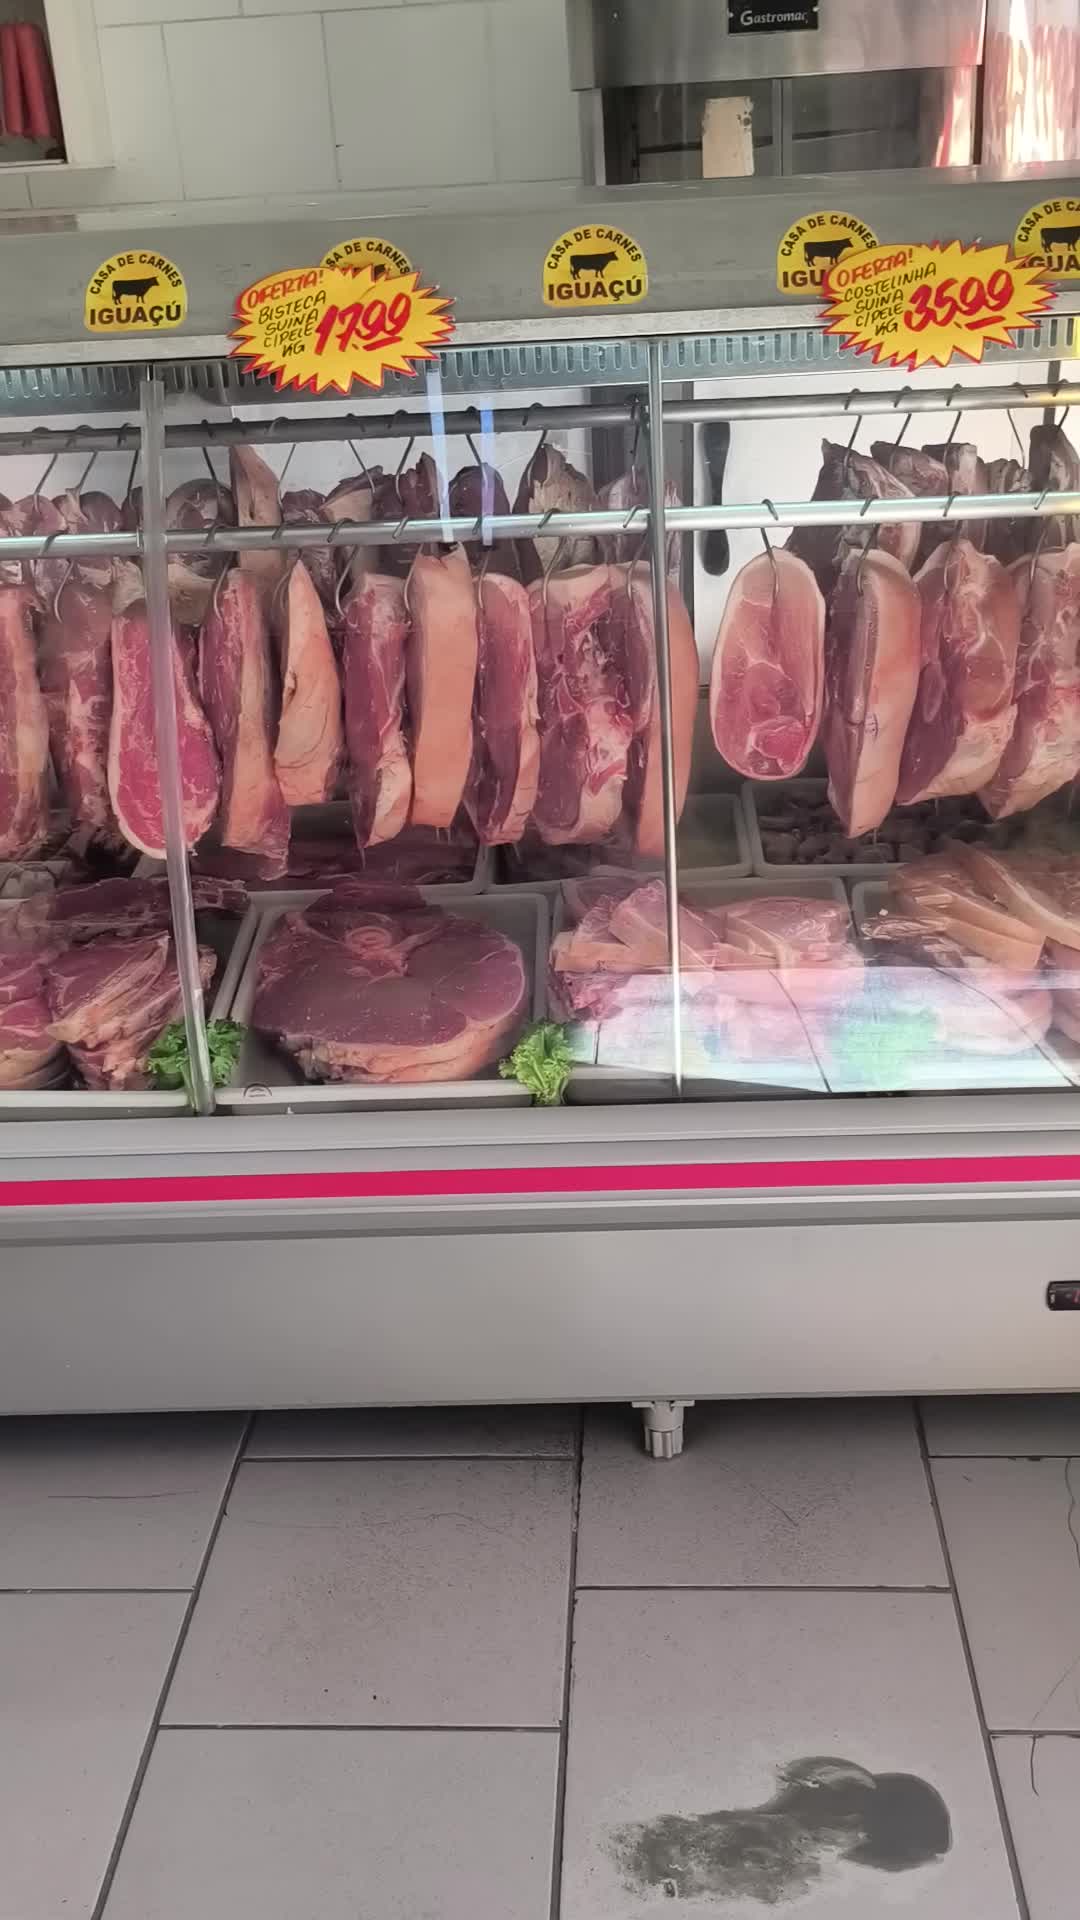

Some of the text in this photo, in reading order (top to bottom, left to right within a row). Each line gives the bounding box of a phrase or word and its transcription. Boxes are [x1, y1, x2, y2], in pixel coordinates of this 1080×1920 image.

[781, 215, 877, 256] CASA DE CARNES
[1018, 211, 1043, 242] CASA
[1043, 201, 1062, 215] DE
[324, 252, 343, 268] SA
[344, 242, 361, 255] DE
[547, 228, 641, 270] CASA DE CARNES
[90, 254, 182, 294] CASA DE CARNES
[782, 269, 826, 288] IGU
[836, 248, 913, 287] OFERTA!
[844, 262, 936, 303] COSTELINHA
[248, 270, 323, 308] OFERTA!
[548, 275, 642, 301] IGUAÇÚ
[854, 288, 904, 314] SUINA
[90, 301, 181, 326] IGUAÇÚ
[258, 290, 326, 324] BISTECA
[264, 308, 318, 335] SUINA
[874, 318, 898, 336] KG
[281, 343, 305, 357] KG
